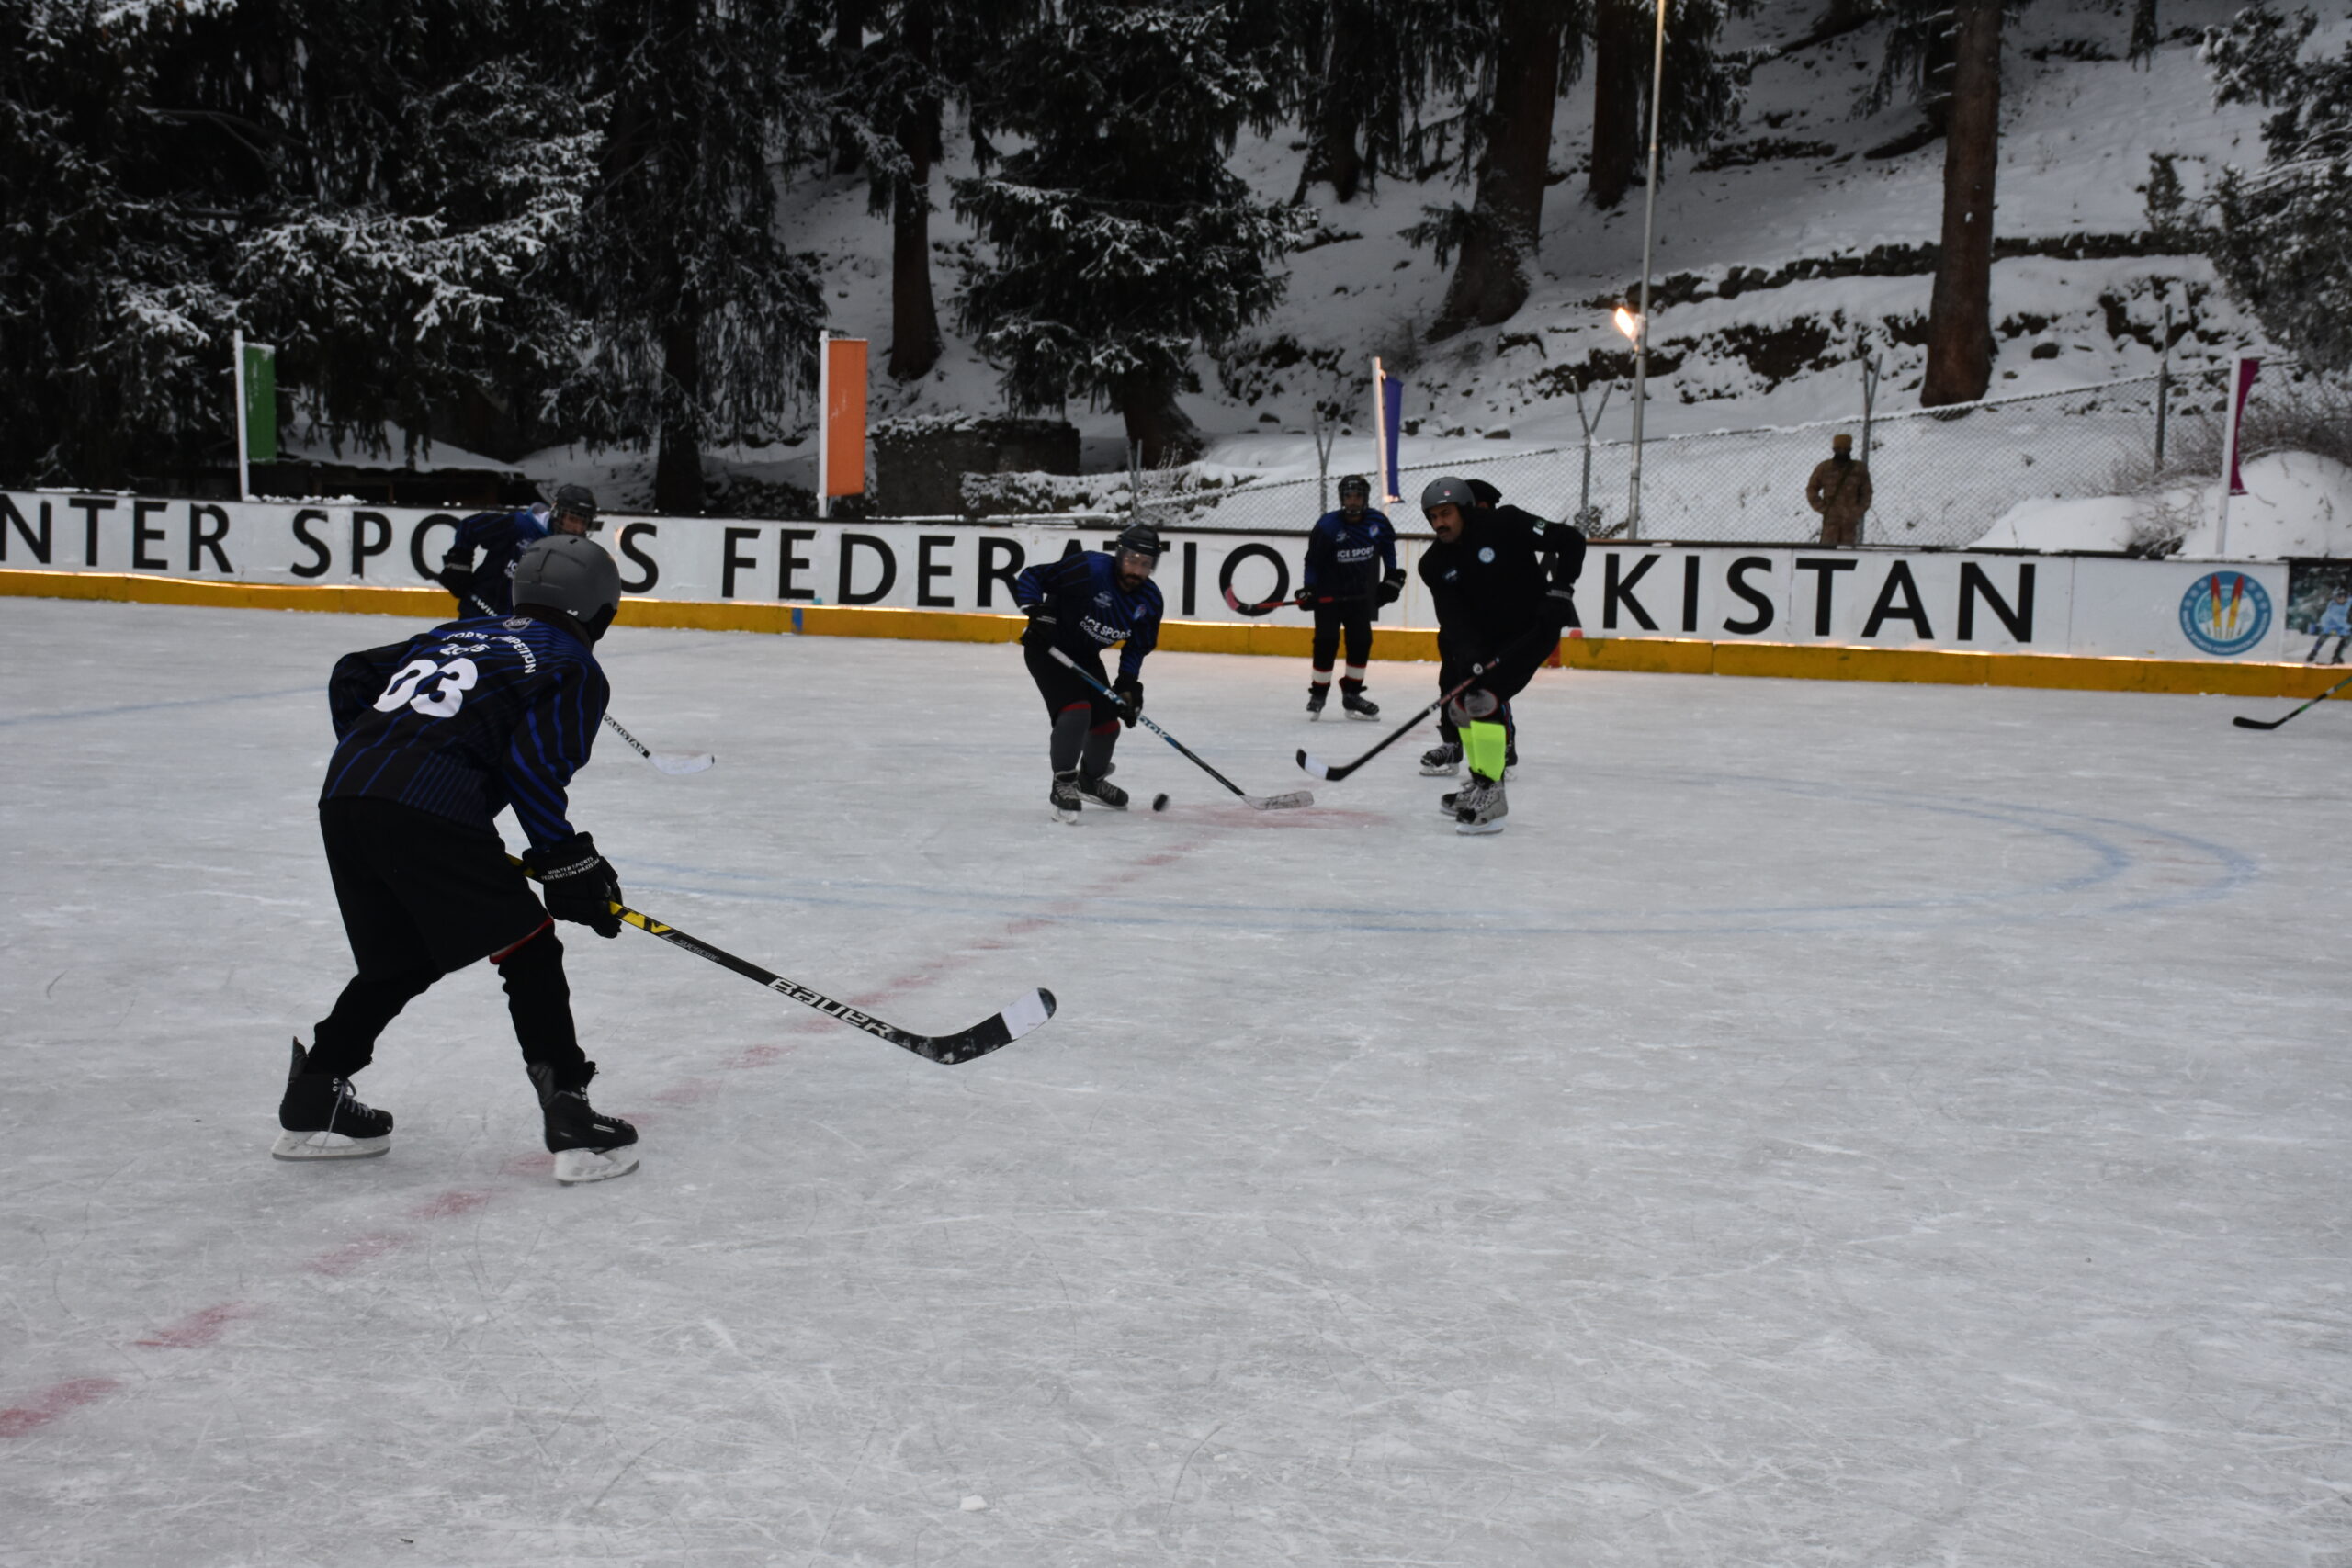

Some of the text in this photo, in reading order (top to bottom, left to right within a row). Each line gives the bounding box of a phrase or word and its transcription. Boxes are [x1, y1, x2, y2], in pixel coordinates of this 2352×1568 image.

[0, 493, 2036, 644] NTER SPOS FEDERIO KISTAN
[373, 657, 478, 718] 03
